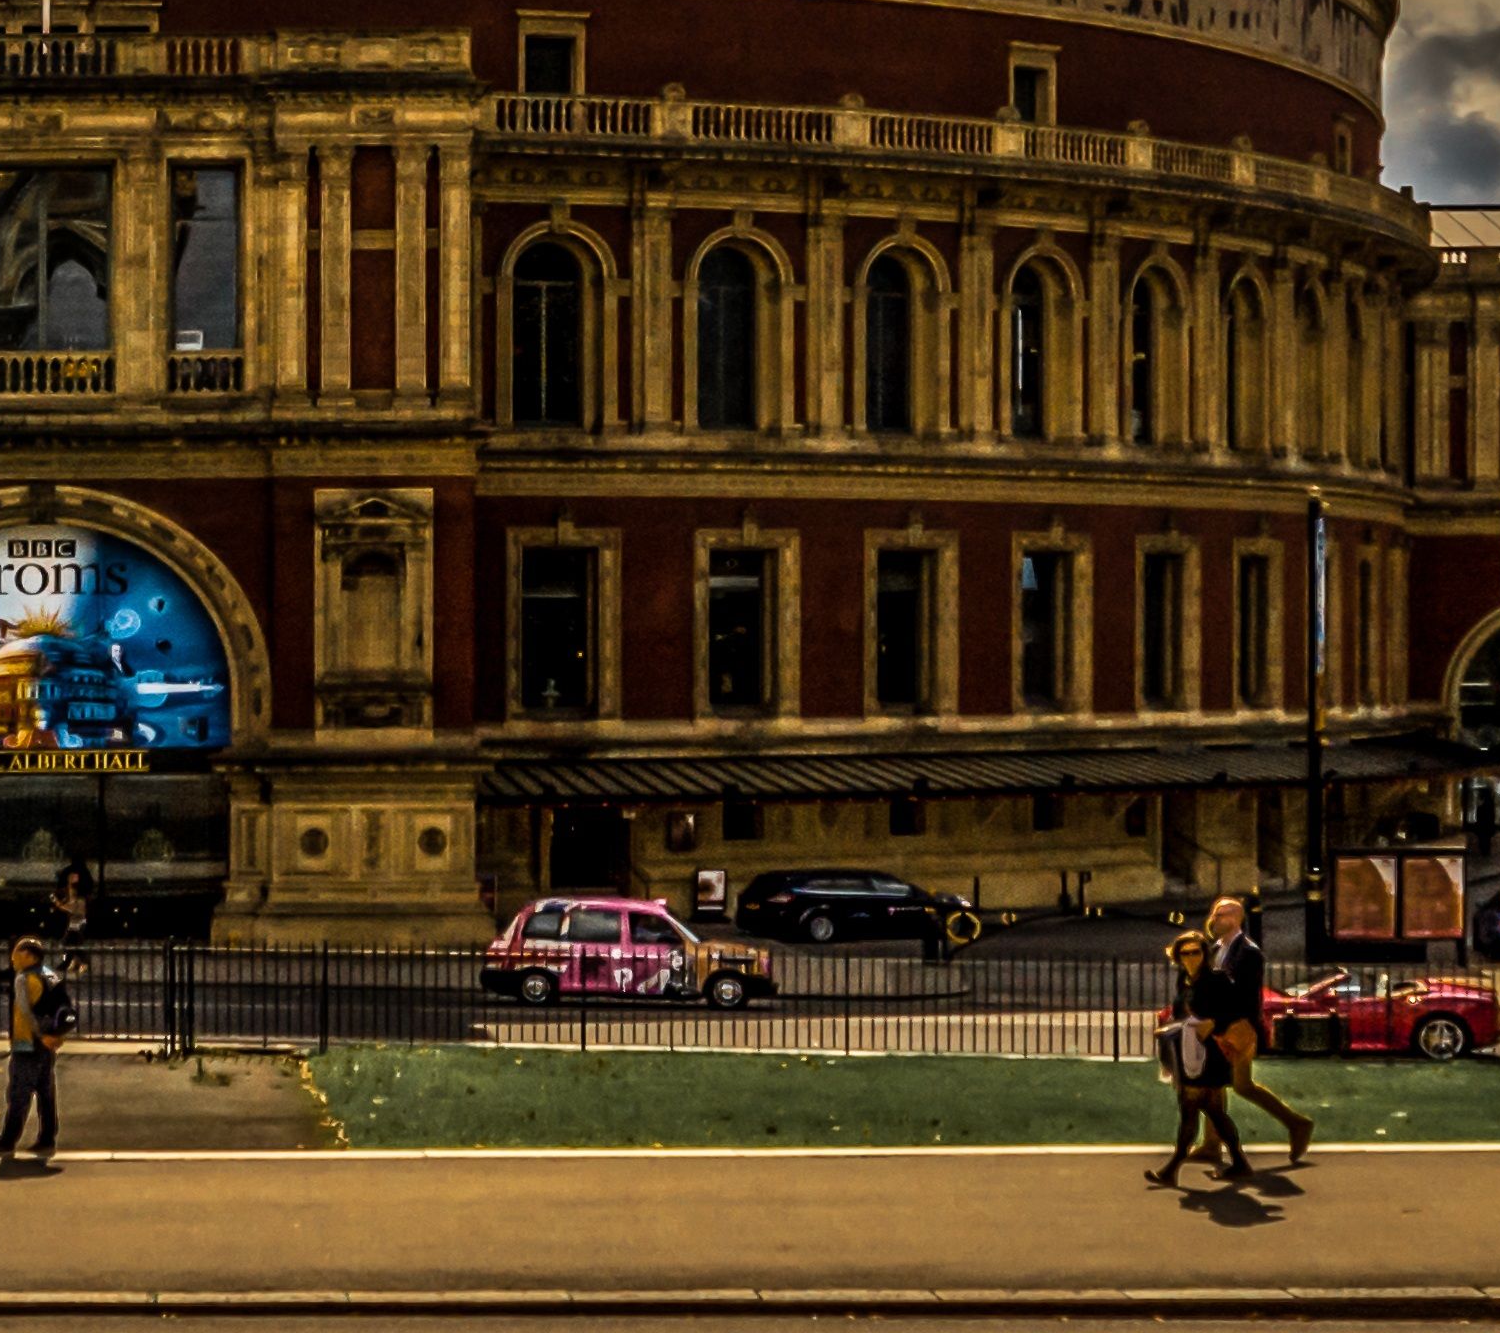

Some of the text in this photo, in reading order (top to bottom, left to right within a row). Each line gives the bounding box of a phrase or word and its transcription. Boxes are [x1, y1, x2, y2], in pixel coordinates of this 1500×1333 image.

[9, 540, 76, 558] BBC
[9, 752, 86, 771] ALBERT
[95, 751, 150, 770] HALL
